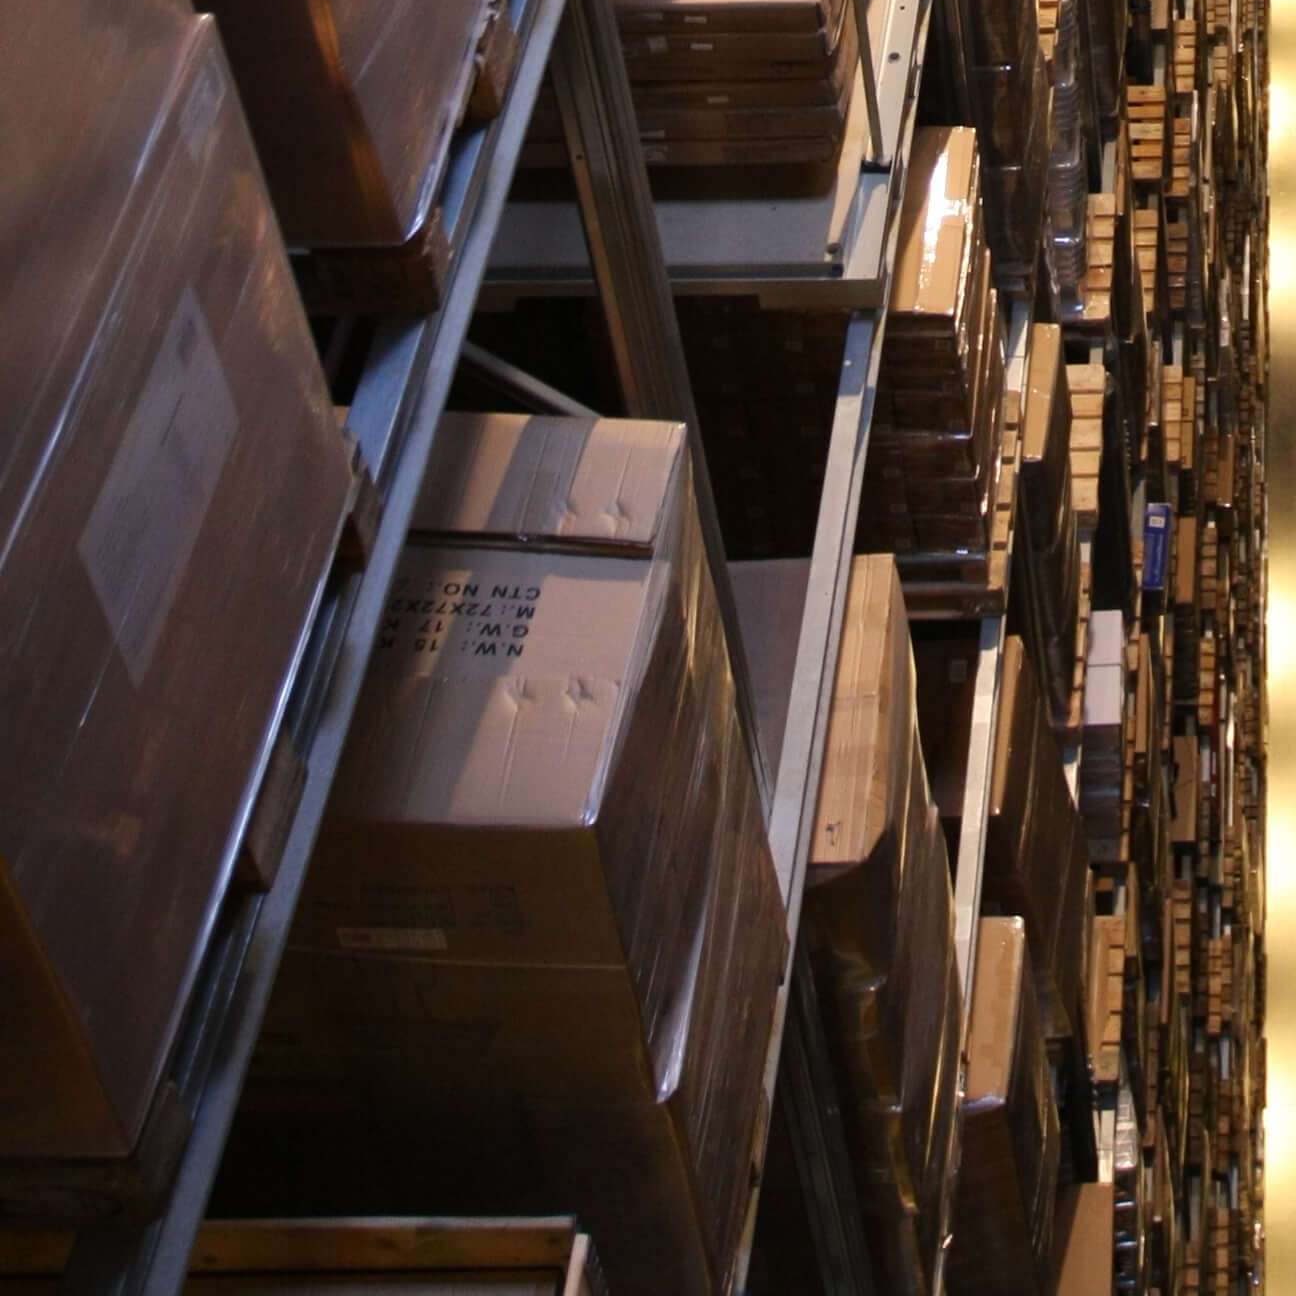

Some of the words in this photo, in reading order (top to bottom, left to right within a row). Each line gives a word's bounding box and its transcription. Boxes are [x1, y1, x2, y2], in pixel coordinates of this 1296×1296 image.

[492, 586, 541, 601] CTN
[466, 621, 529, 638] G.W.:
[460, 641, 524, 657] N.W.:
